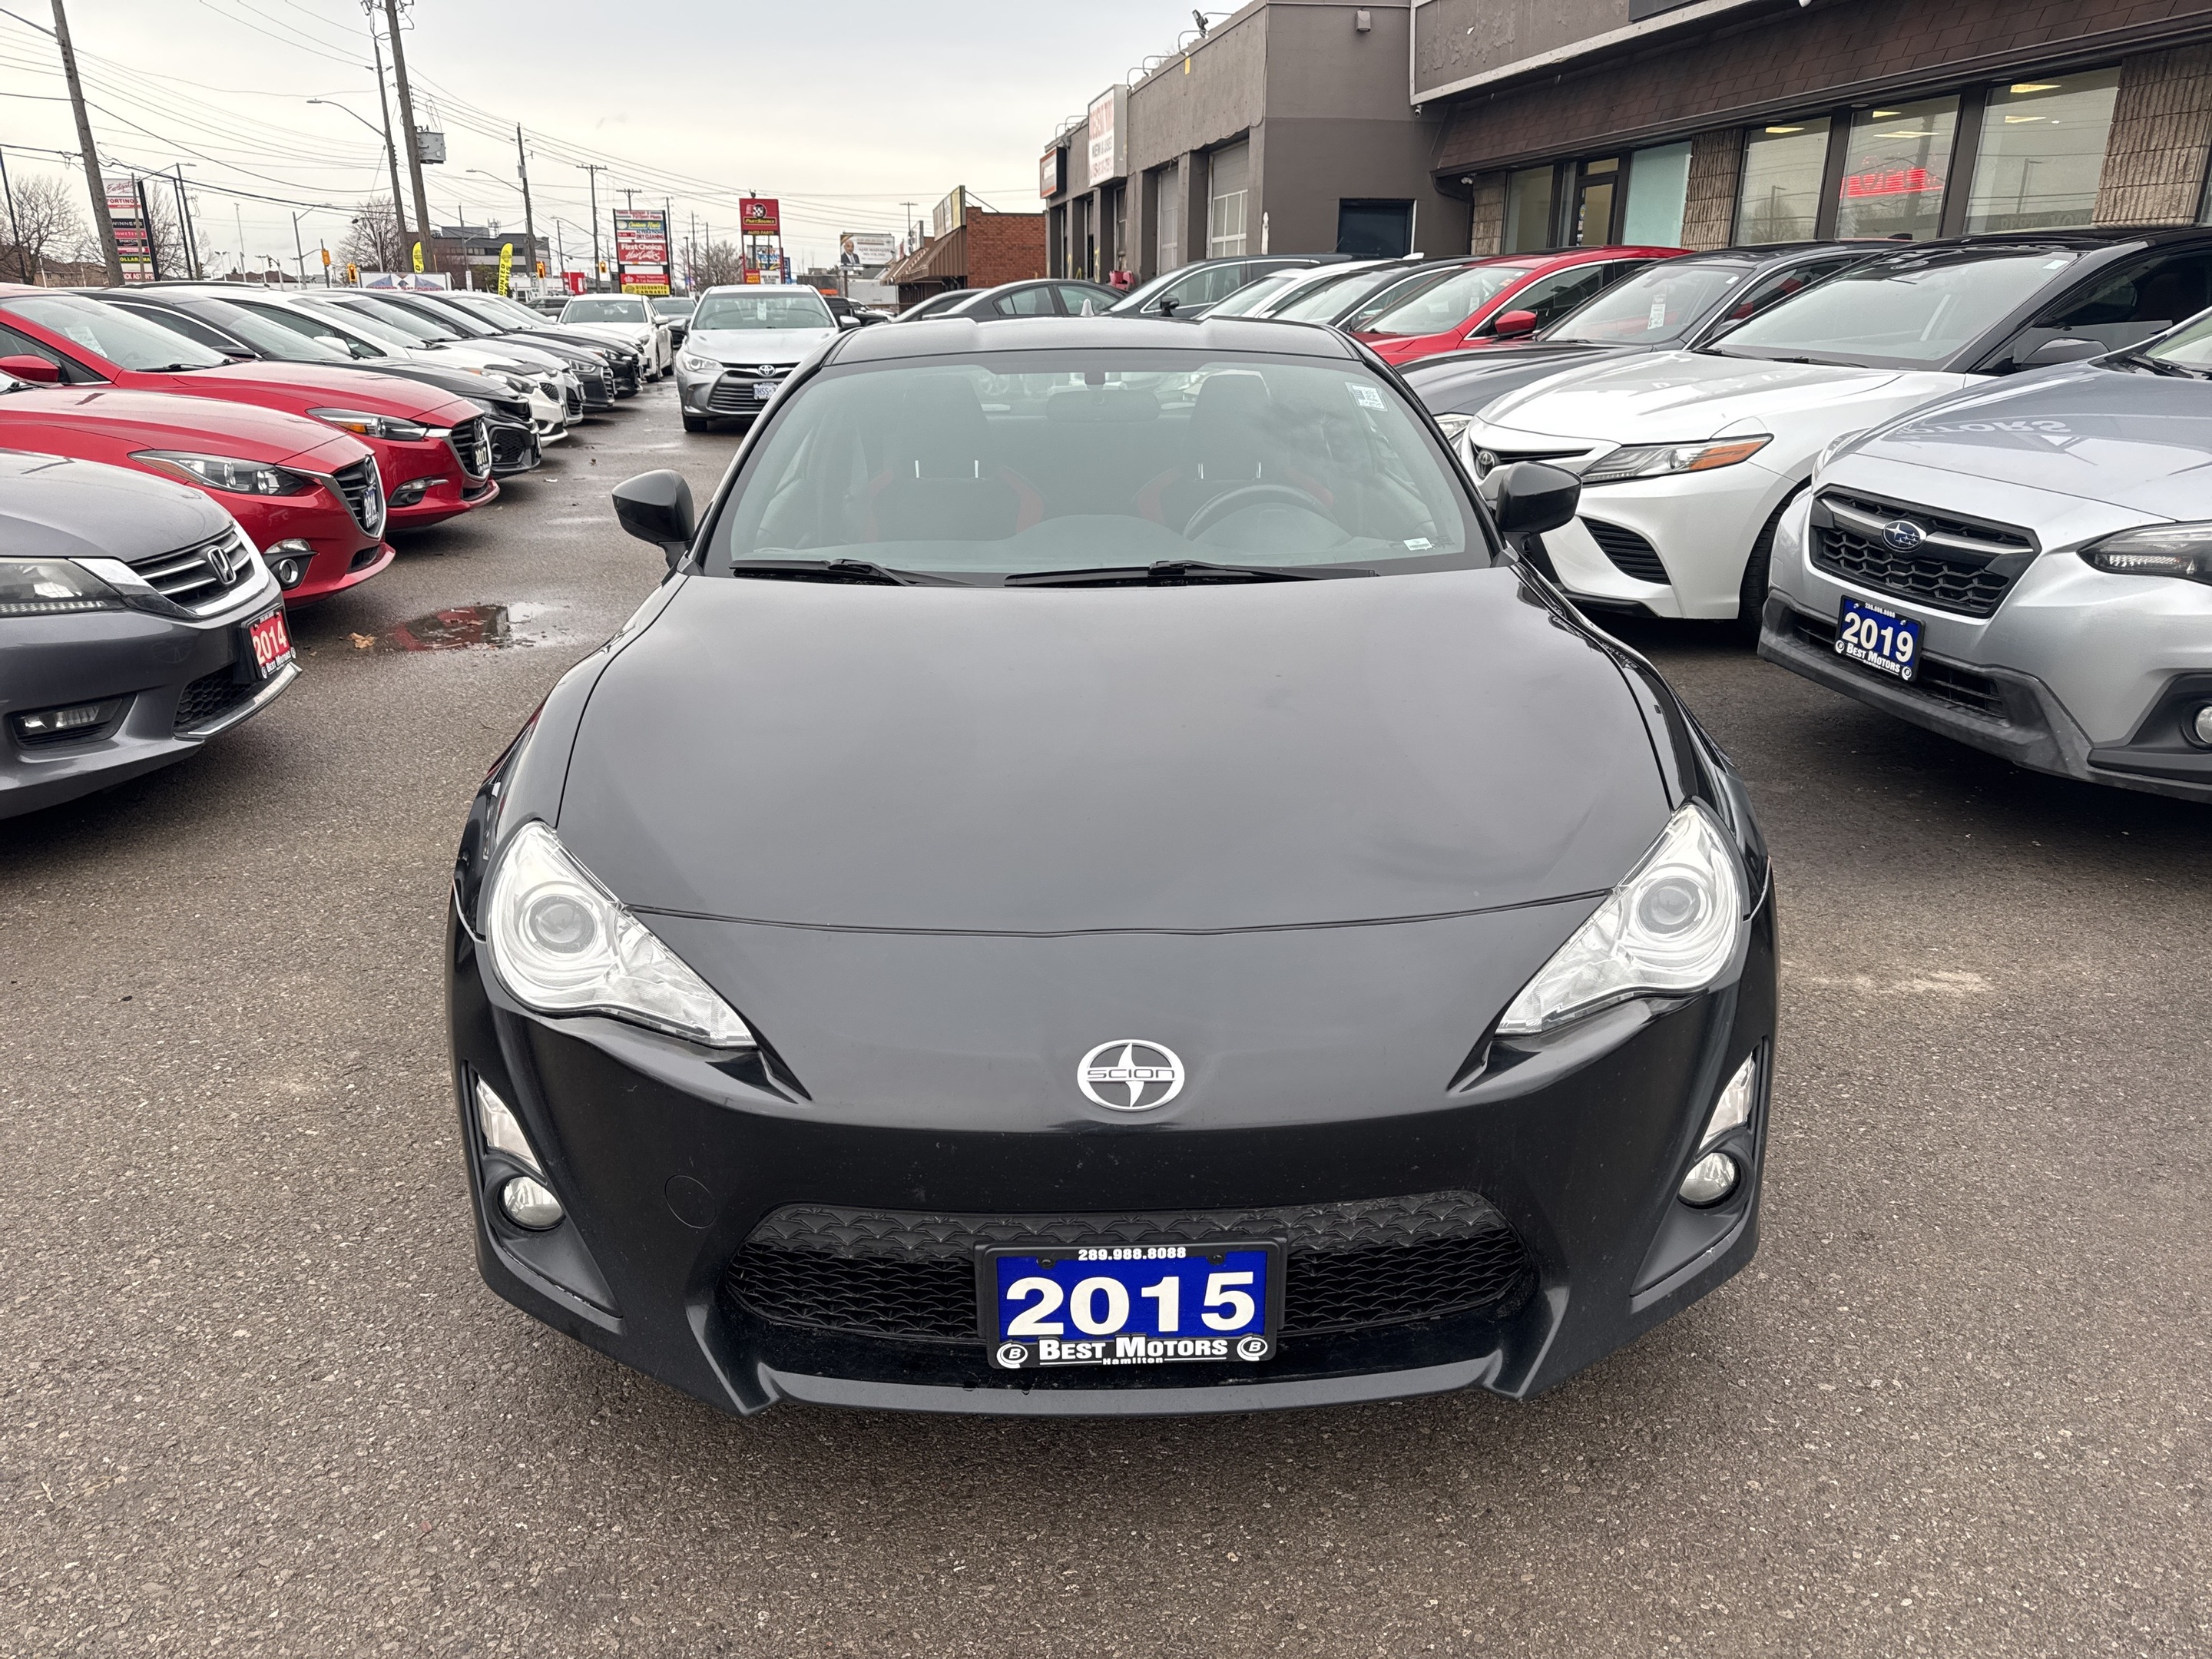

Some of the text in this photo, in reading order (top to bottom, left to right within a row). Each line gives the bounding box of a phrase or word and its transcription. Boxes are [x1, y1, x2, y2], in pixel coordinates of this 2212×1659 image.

[253, 621, 287, 665] 2014
[1842, 612, 1913, 663] 2019
[1846, 643, 1901, 673] BEST MOTORS
[1078, 1247, 1187, 1261] 289.988.8088
[1006, 1271, 1256, 1336] 2015
[1038, 1336, 1228, 1360] BEST MOTORS
[1102, 1356, 1164, 1366] Hamilton
